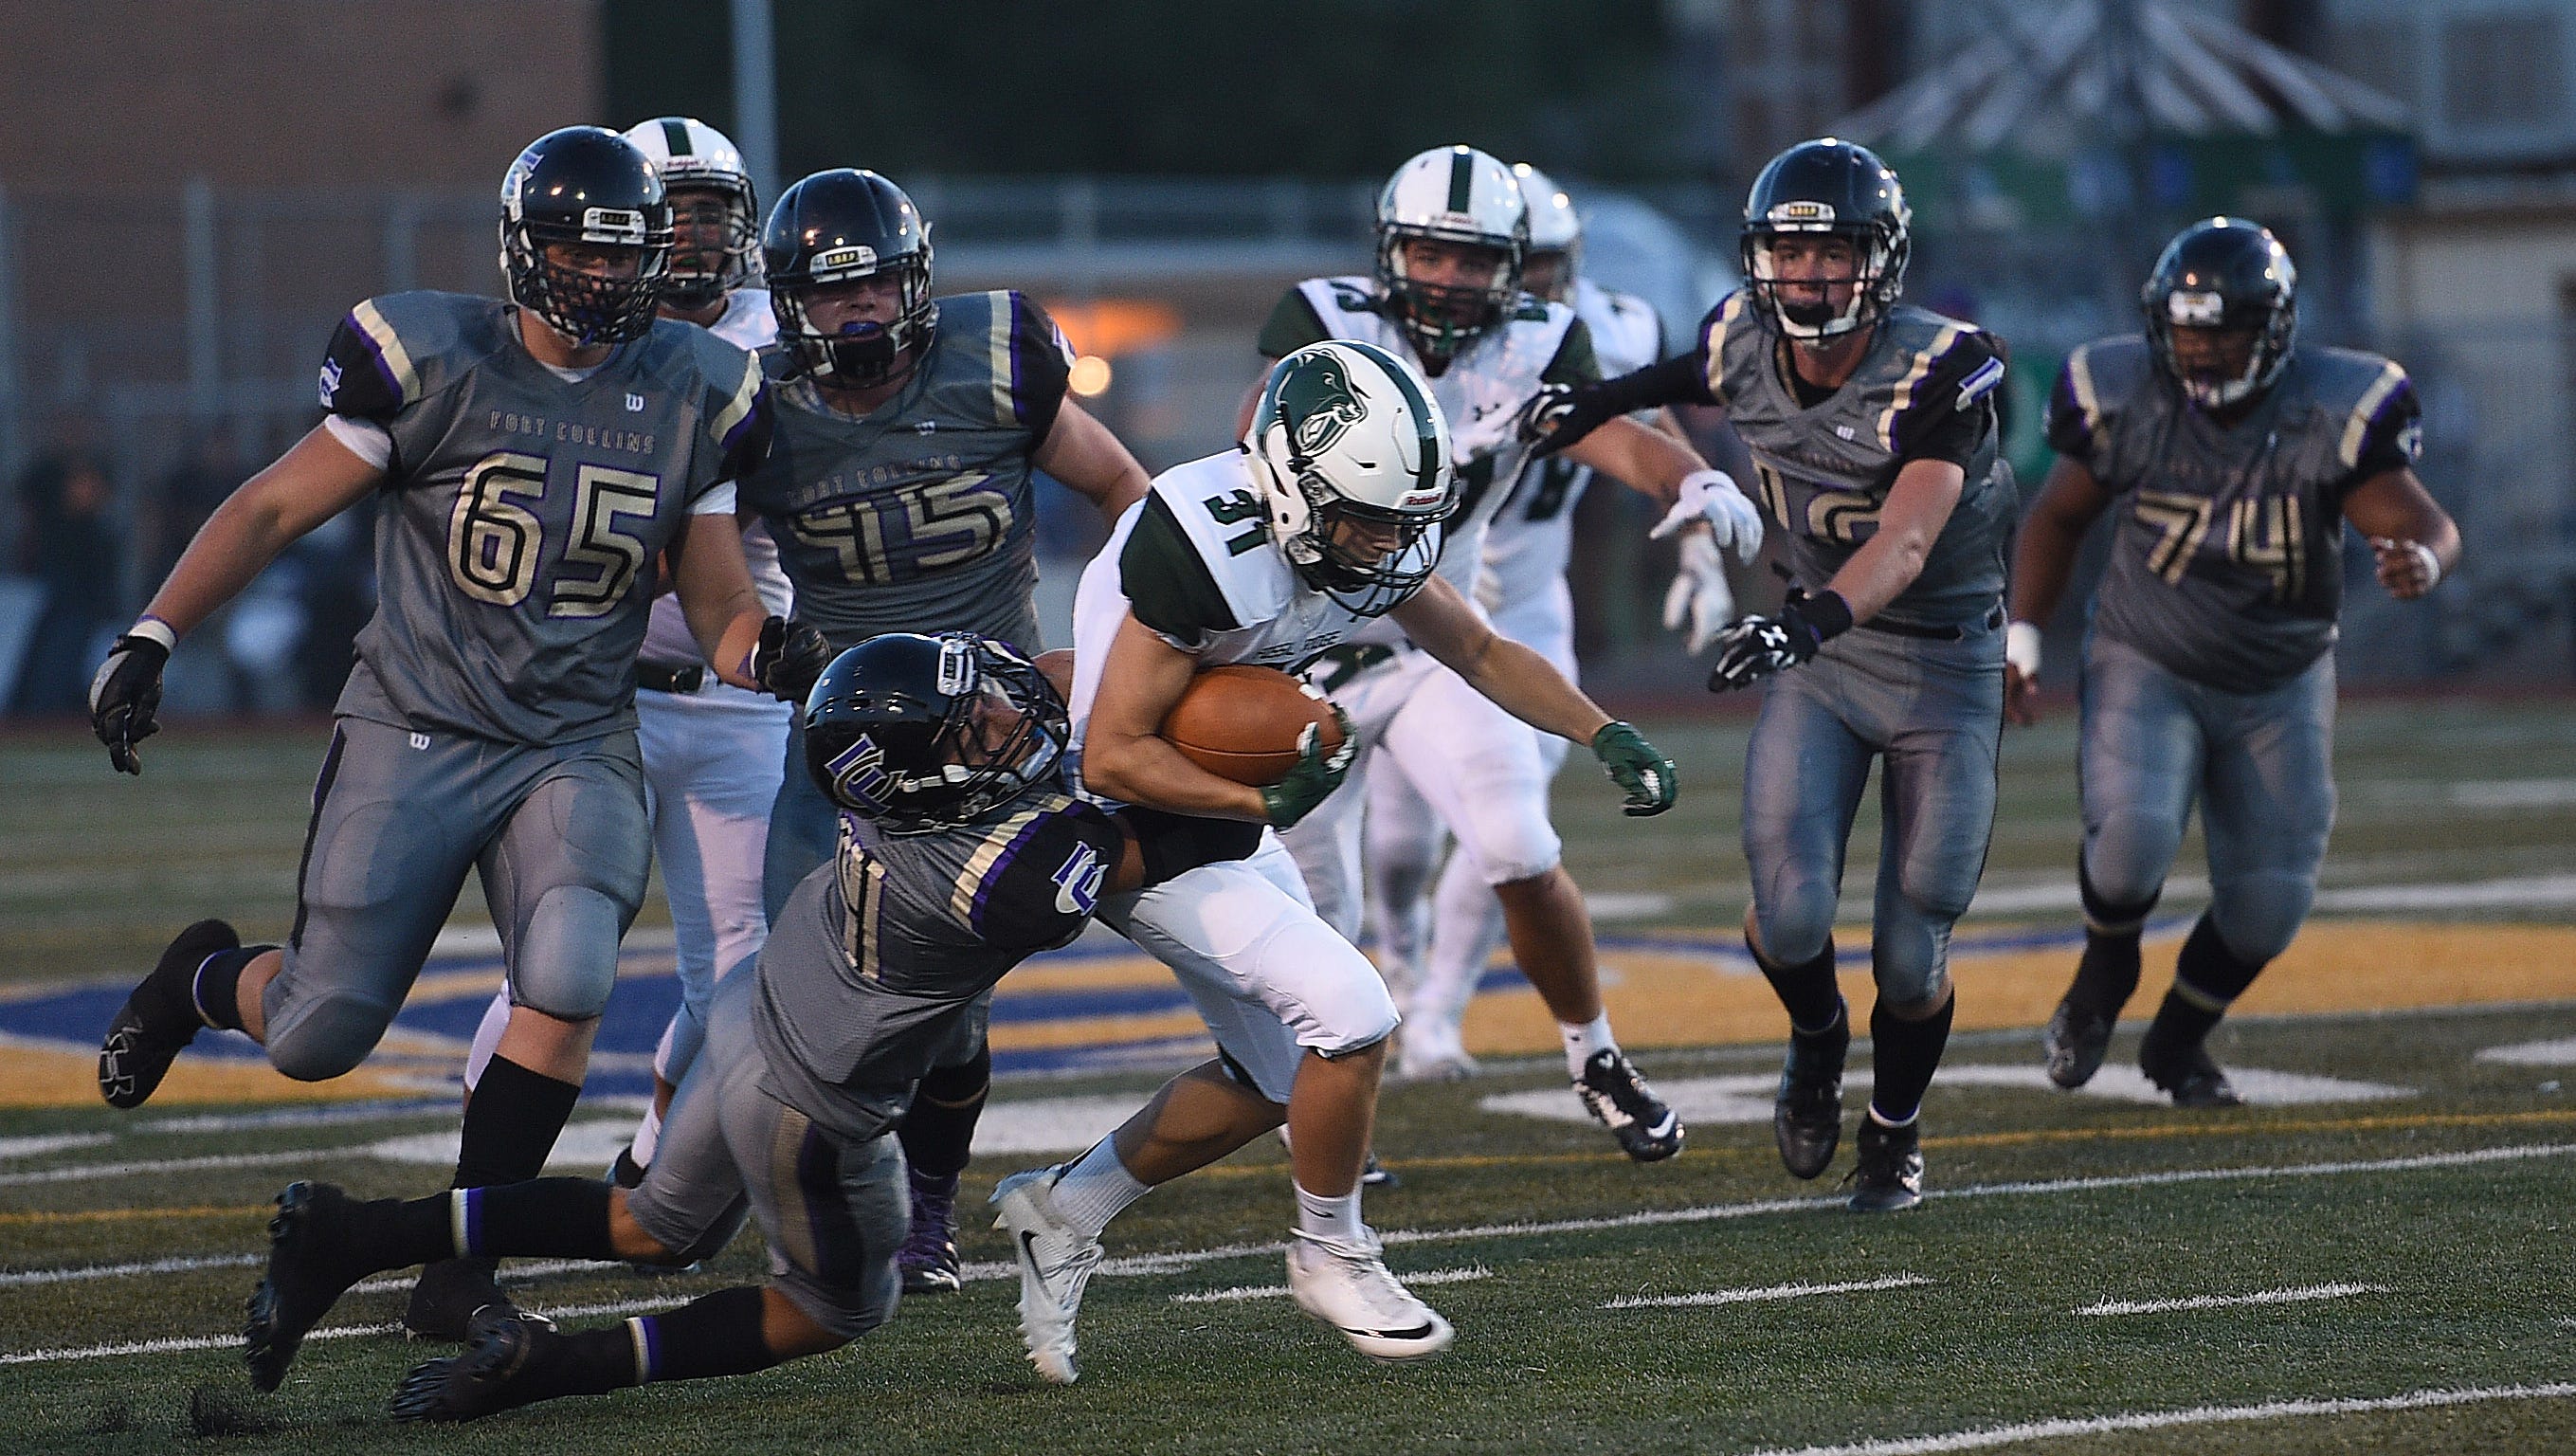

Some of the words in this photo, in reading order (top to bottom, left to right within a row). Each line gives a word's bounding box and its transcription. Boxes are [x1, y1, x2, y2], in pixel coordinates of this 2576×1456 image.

[490, 410, 546, 437] FORT
[556, 421, 656, 456] COLLINS
[448, 451, 660, 620] 65
[1201, 488, 1271, 558] 31
[2134, 489, 2307, 603] 74
